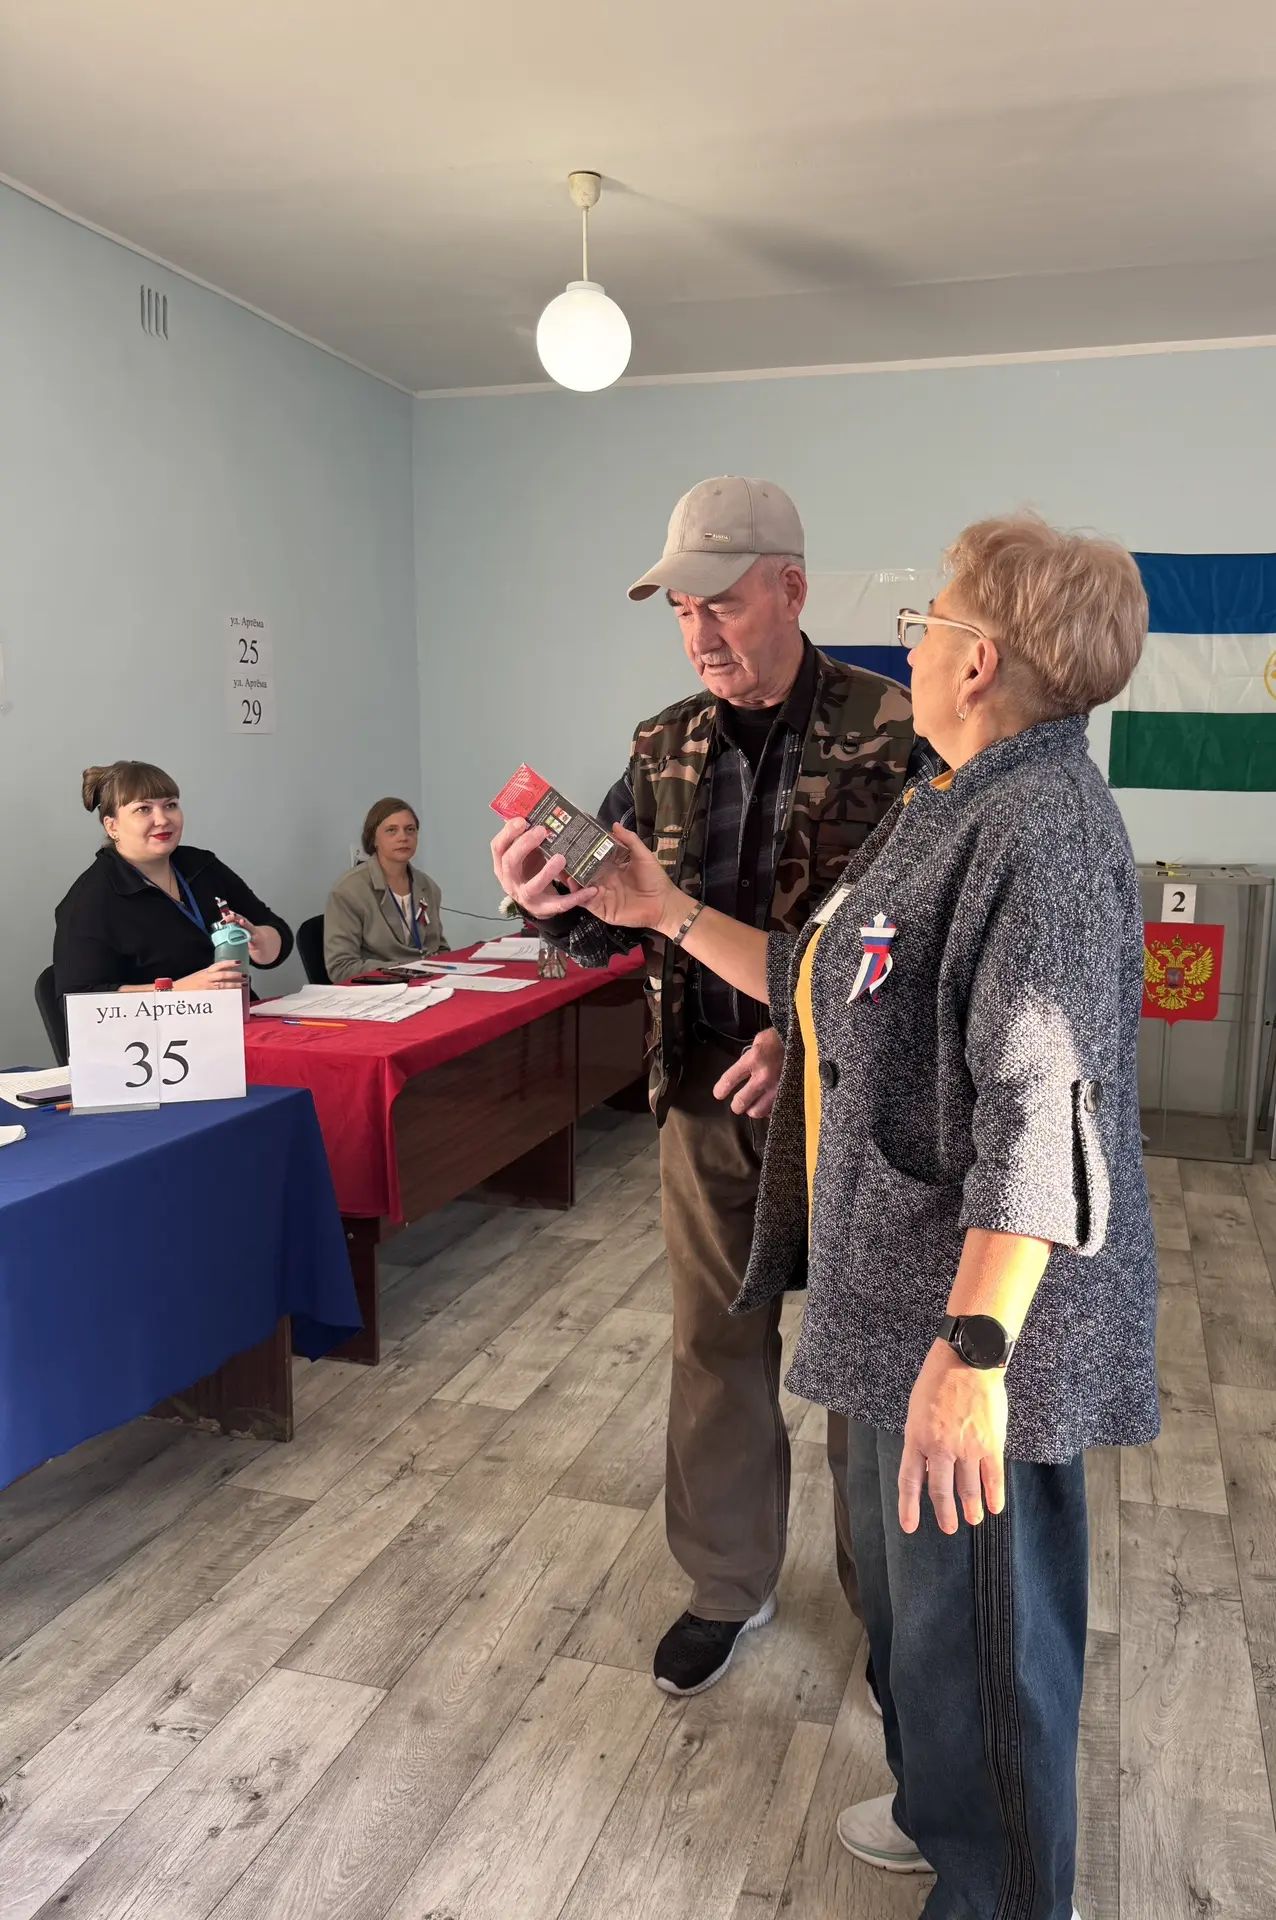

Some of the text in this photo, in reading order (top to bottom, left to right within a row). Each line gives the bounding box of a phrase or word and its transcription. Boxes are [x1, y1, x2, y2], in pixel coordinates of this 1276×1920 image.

[230, 617, 264, 629] ул. Артёма
[239, 638, 259, 664] 25
[233, 678, 267, 690] ул. Артёма
[241, 699, 262, 725] 29
[1171, 890, 1186, 912] 2
[96, 1000, 213, 1023] ул. Артёма
[124, 1039, 189, 1088] 35
